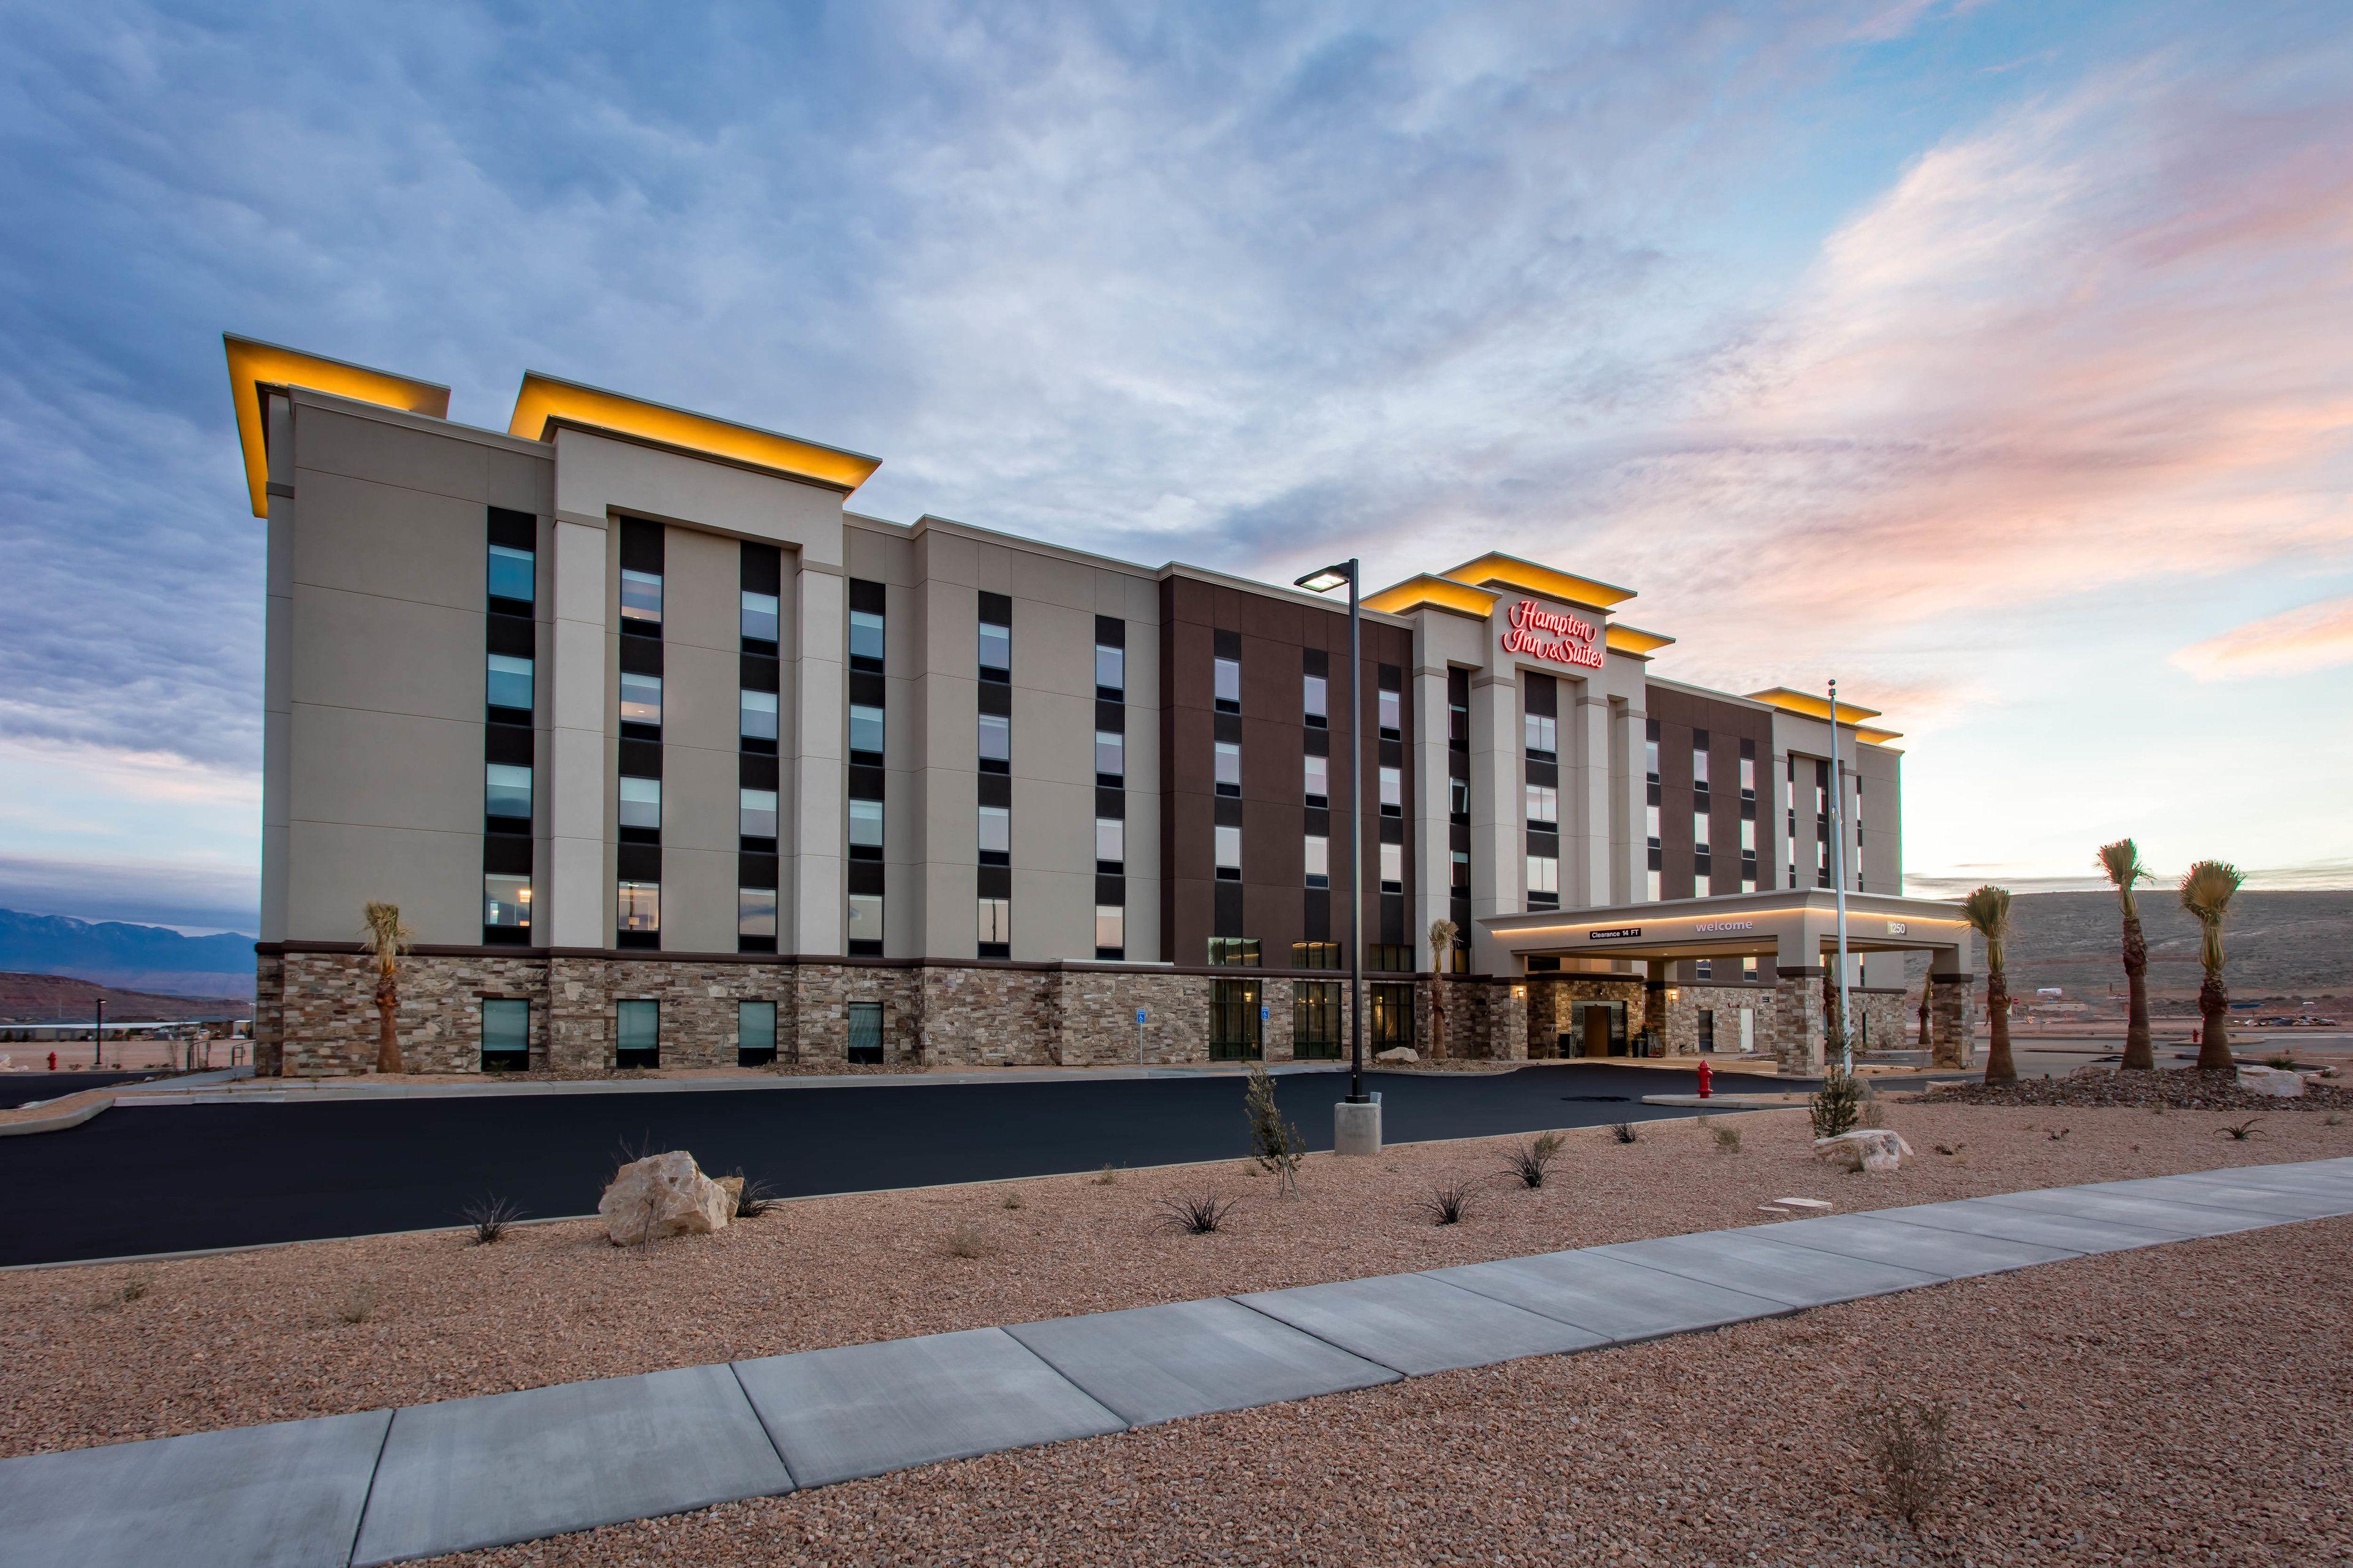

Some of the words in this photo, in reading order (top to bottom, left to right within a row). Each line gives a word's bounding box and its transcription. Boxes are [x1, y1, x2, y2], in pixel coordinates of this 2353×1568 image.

[1508, 600, 1597, 643] Hampton
[1501, 628, 1549, 659] Inn
[1559, 639, 1604, 668] Suites
[1696, 921, 1752, 932] welcome
[1890, 923, 1905, 934] 1250
